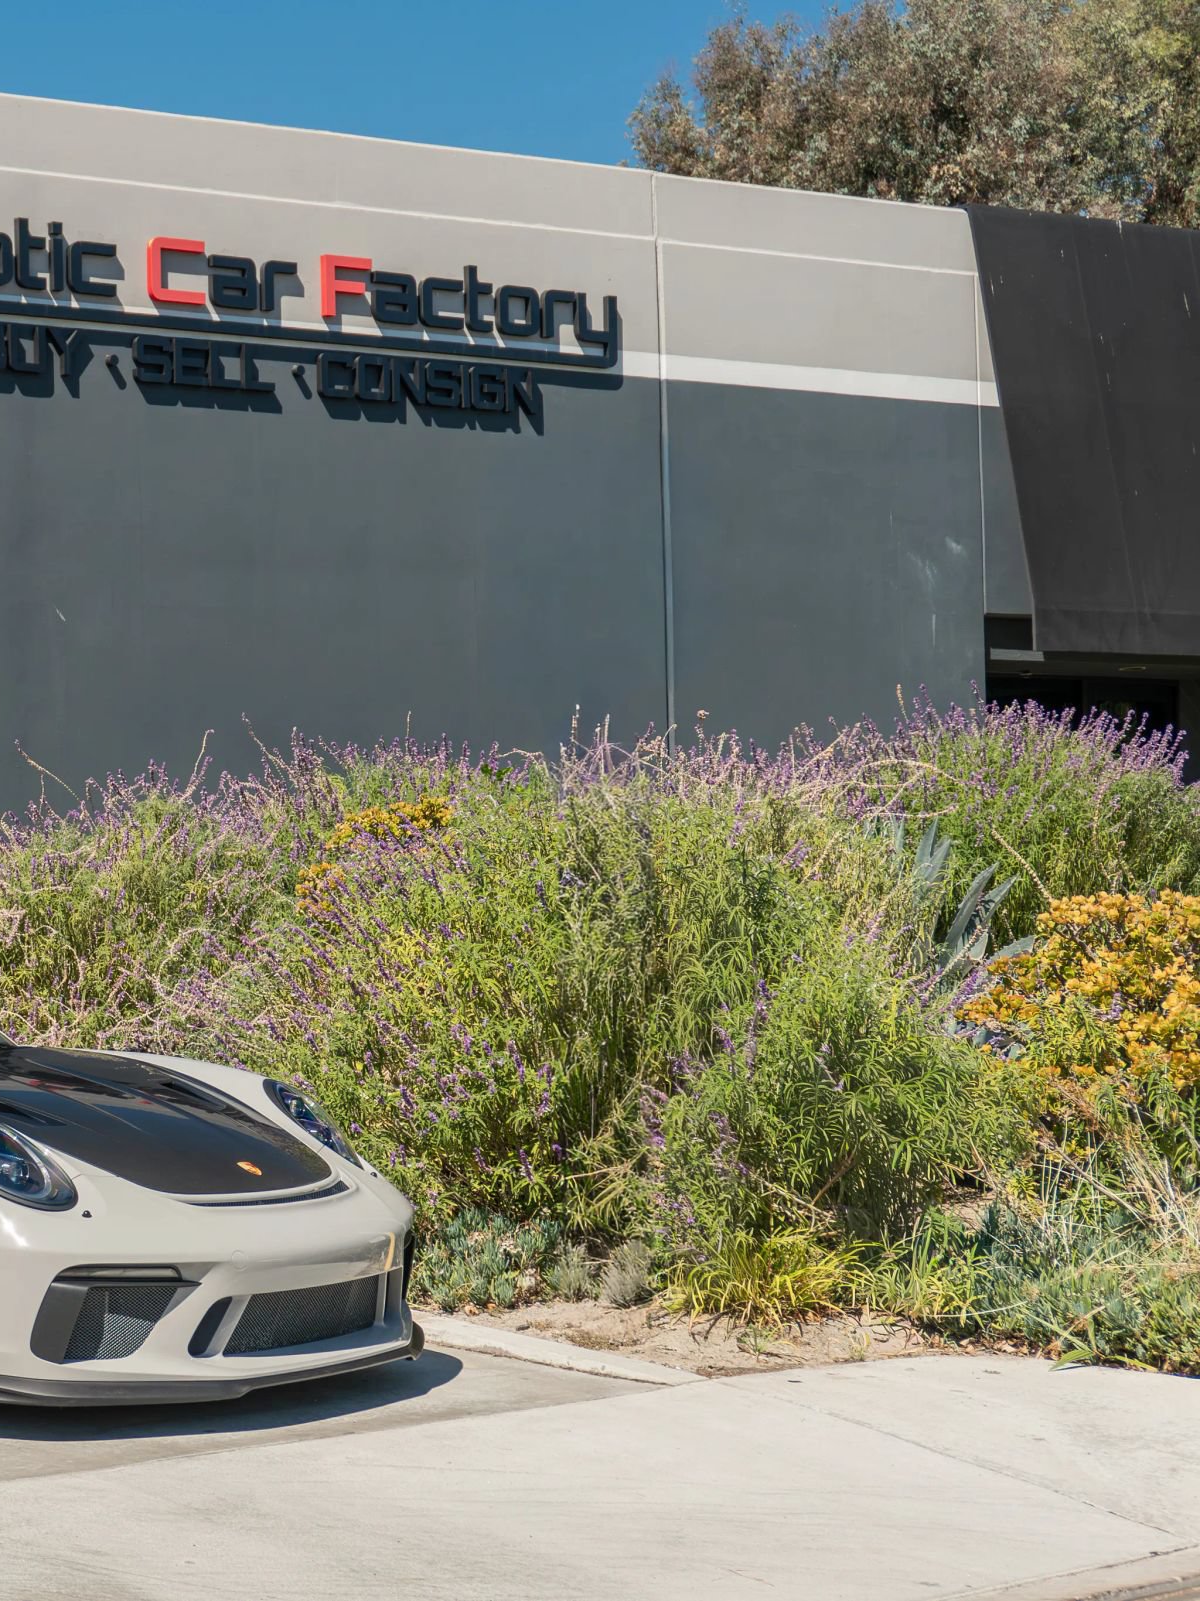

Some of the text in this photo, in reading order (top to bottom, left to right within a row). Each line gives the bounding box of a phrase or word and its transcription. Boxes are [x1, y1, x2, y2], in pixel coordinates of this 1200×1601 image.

[146, 236, 298, 312] Car
[320, 254, 618, 369] Factory
[132, 336, 276, 392] SELL
[316, 352, 537, 415] CONSIGN
